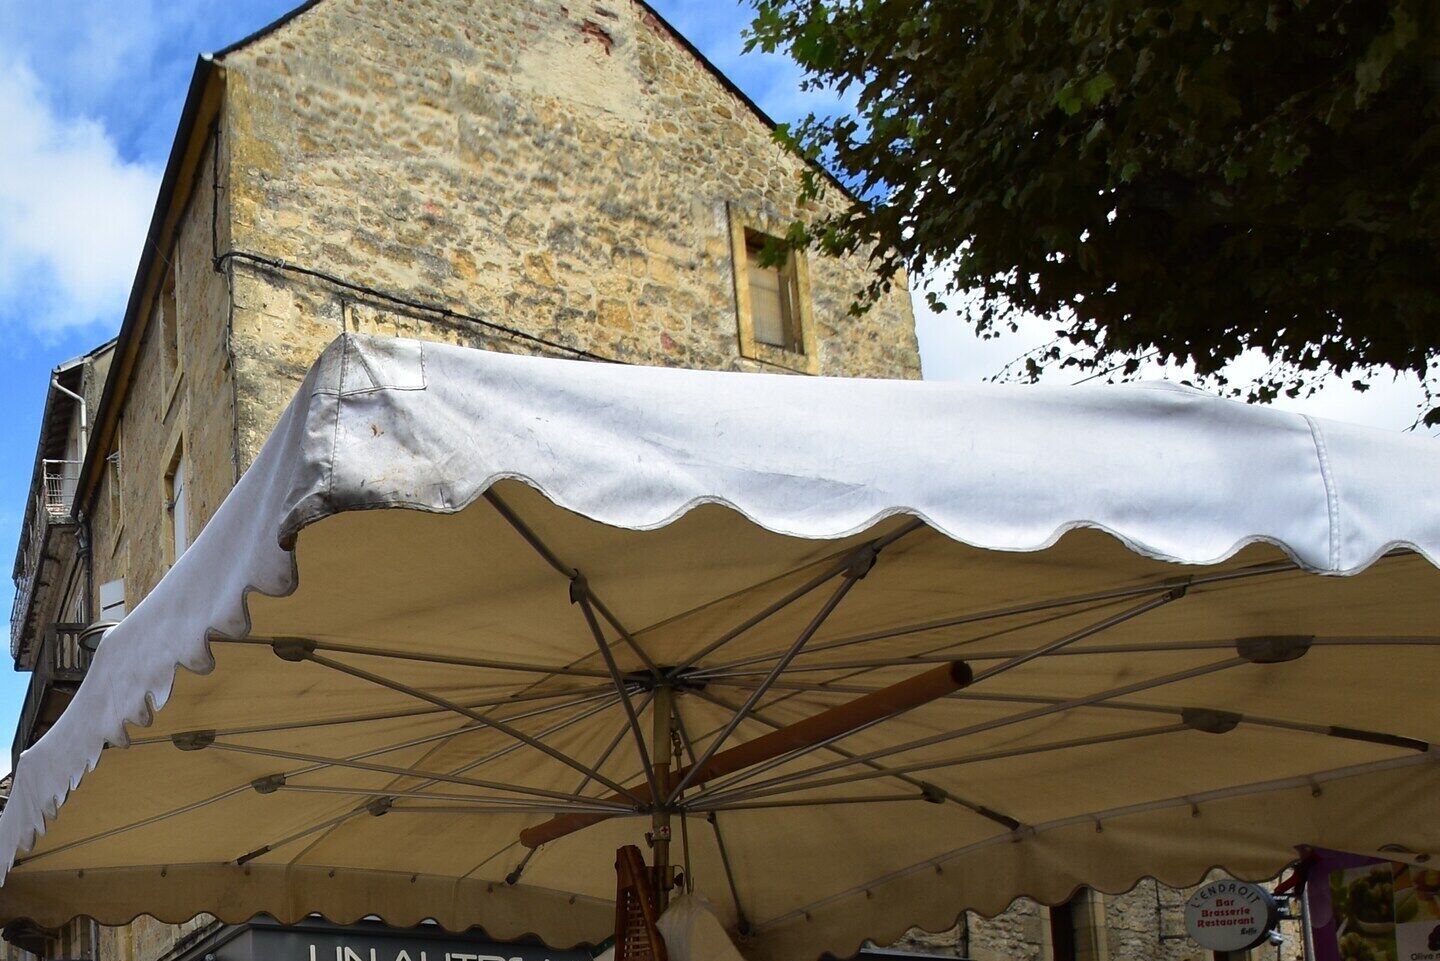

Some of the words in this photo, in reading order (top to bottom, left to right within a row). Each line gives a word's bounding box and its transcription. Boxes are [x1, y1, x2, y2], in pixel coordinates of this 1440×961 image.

[1191, 883, 1261, 909] L'ENDROIT
[1215, 899, 1234, 908] Bar
[1201, 908, 1251, 917] Brasserie
[1197, 917, 1255, 928] Restaurant
[1410, 952, 1435, 961] Olive
